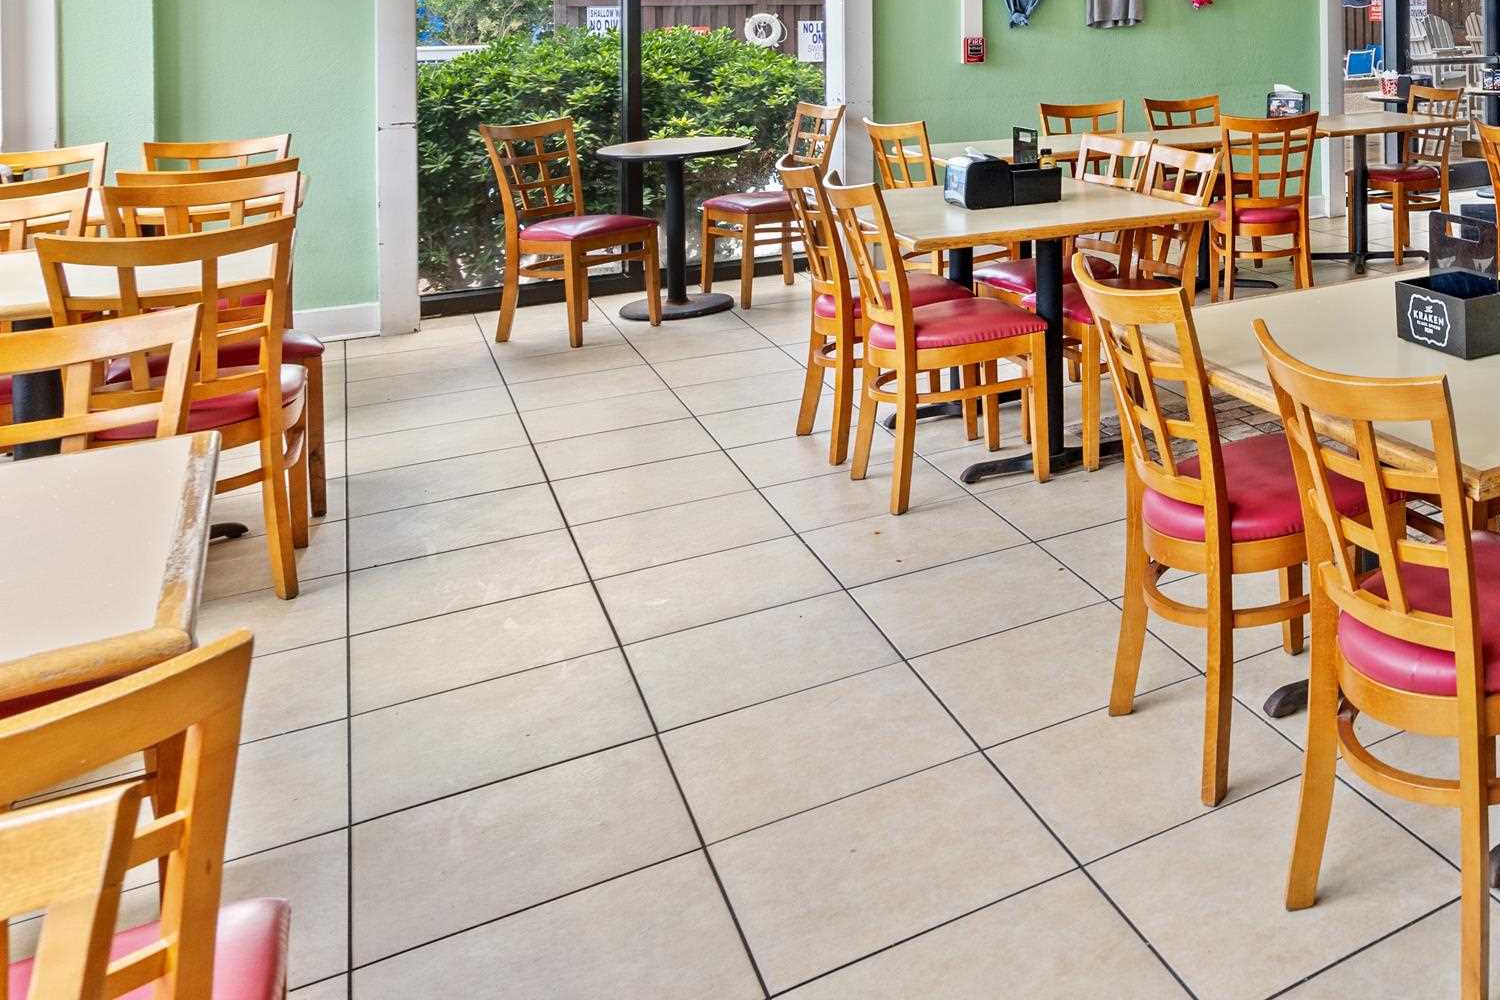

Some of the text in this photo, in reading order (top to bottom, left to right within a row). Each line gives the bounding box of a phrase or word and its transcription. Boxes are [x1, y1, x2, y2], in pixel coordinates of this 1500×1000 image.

[590, 10, 614, 18] SHALLOW
[590, 20, 601, 31] NO
[803, 24, 814, 33] NO
[1413, 310, 1444, 327] KRAKEN
